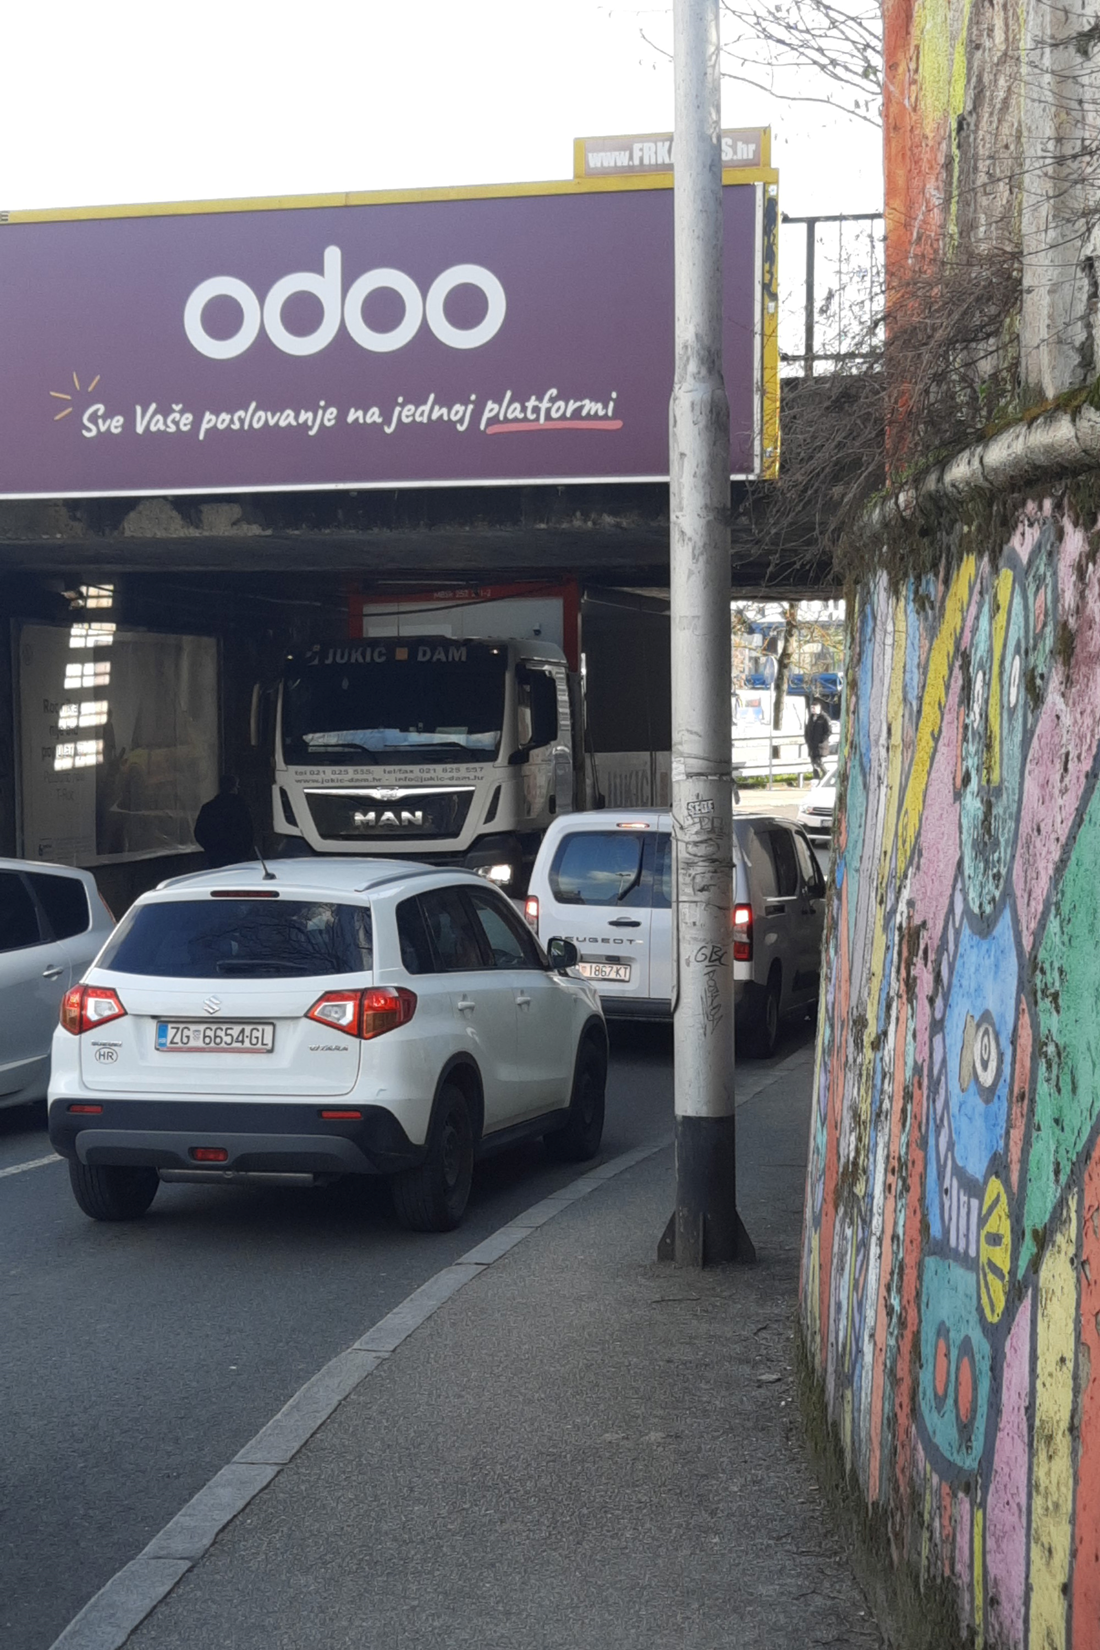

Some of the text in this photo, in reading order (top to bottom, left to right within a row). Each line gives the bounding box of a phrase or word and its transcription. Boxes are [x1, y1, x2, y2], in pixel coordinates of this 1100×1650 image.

[184, 245, 506, 359] odoo
[82, 388, 618, 441] Sve Vaše poslovanje na jednoj platformi
[416, 646, 468, 662] DAM
[419, 767, 437, 775] 021
[354, 810, 423, 826] MAN
[169, 1026, 191, 1046] ZG
[98, 1050, 115, 1061] HR
